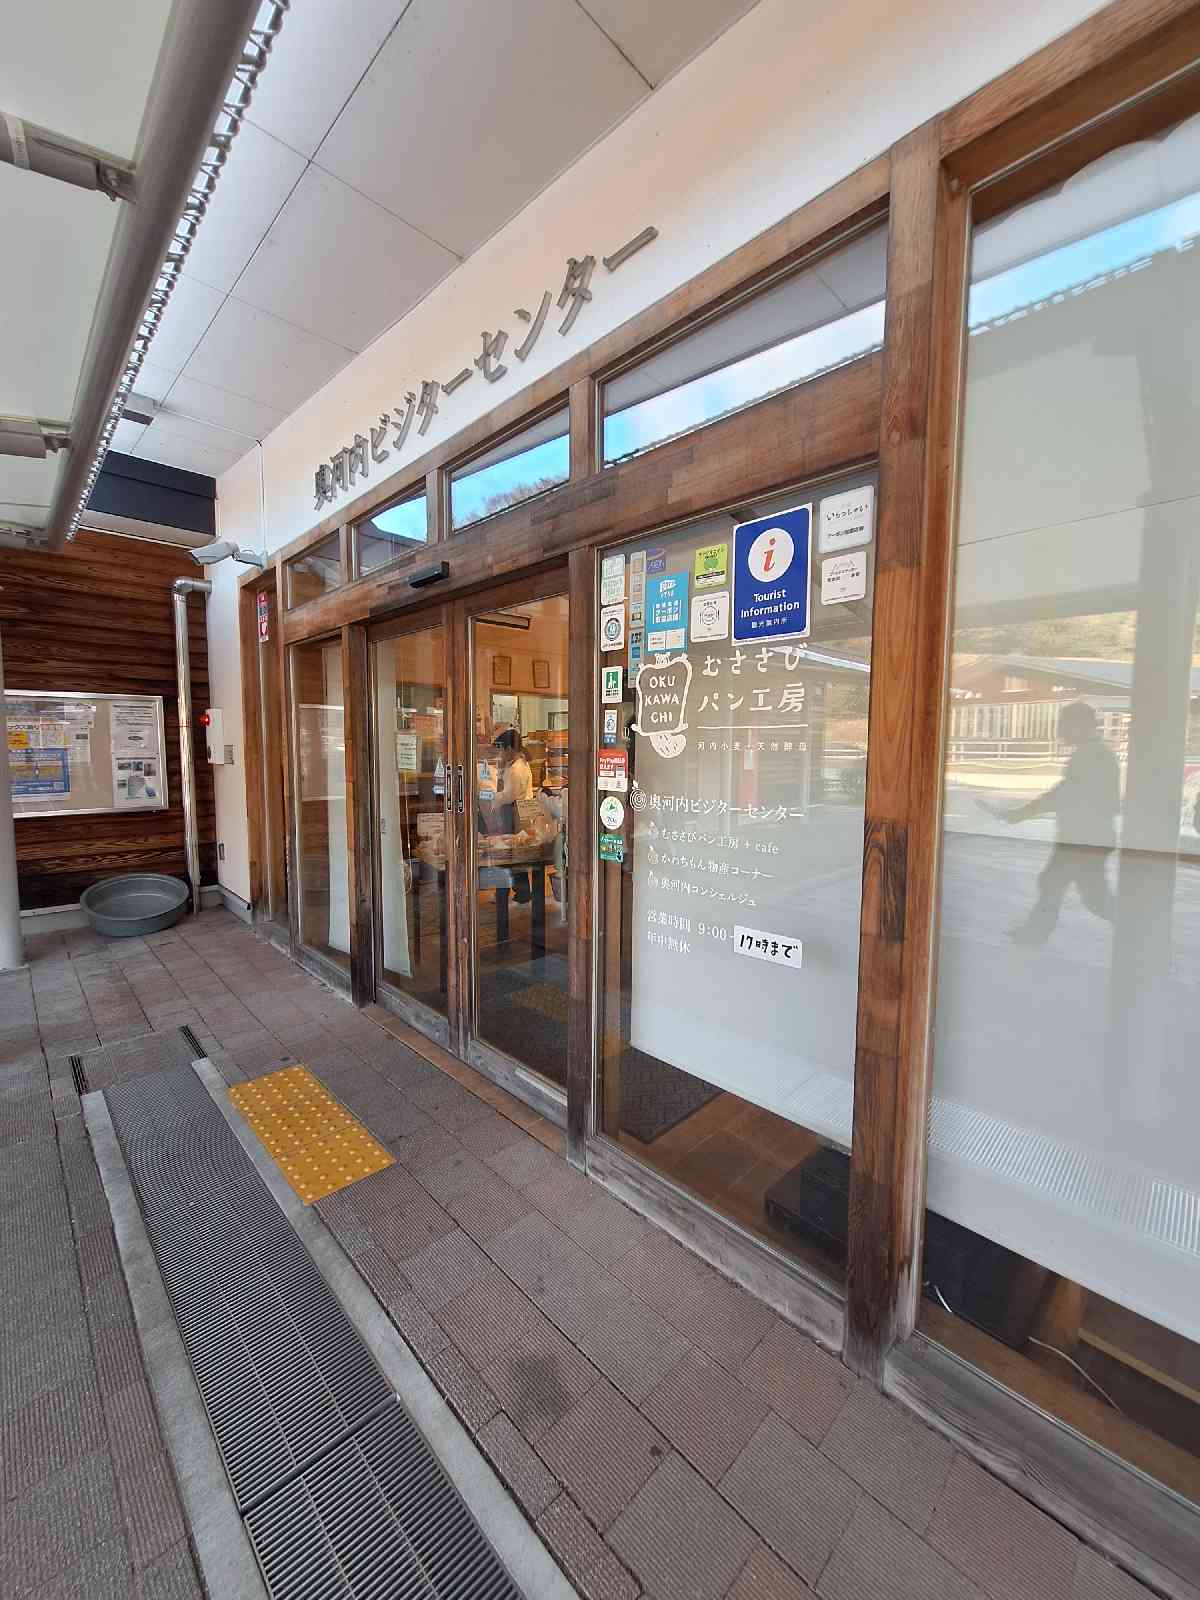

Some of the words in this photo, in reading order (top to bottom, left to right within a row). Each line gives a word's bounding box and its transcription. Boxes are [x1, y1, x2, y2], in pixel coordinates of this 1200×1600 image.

[314, 226, 659, 511] 奥河内ビジターセンター
[754, 589, 787, 603] Tourist
[741, 601, 800, 619] Information
[702, 643, 808, 677] むささび
[649, 674, 676, 689] OKU
[645, 694, 680, 707] KAWA
[697, 682, 805, 713] パン工房
[651, 711, 673, 724] CHI
[649, 793, 805, 822] 奥河内ビジターセンター
[755, 841, 780, 855] cafe
[740, 934, 799, 959] 17時まで
